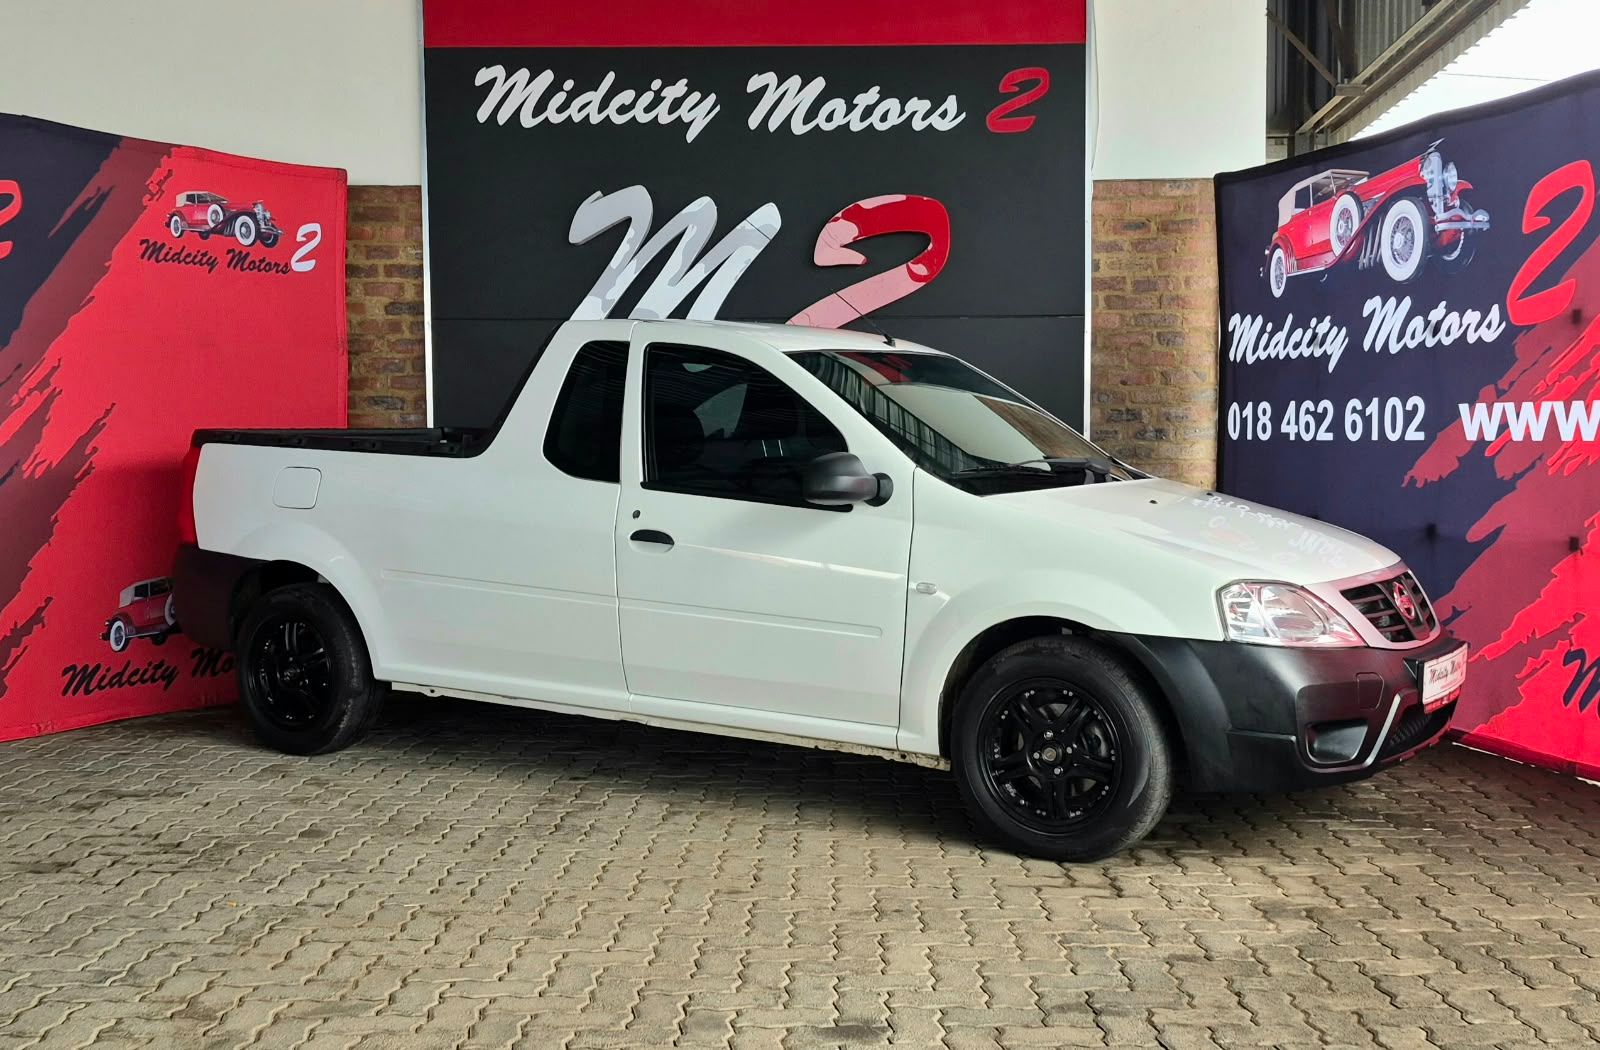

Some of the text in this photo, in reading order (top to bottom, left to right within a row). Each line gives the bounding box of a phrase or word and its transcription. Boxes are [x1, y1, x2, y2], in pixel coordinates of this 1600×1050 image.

[475, 65, 1050, 143] Midcity Motors 2
[139, 222, 322, 275] Midcity Motors 2
[1228, 159, 1596, 373] Midcity Motors 2
[1227, 401, 1272, 441] 018
[1280, 399, 1334, 442] 462
[1344, 395, 1426, 442] 6102
[62, 661, 179, 696] Midcity
